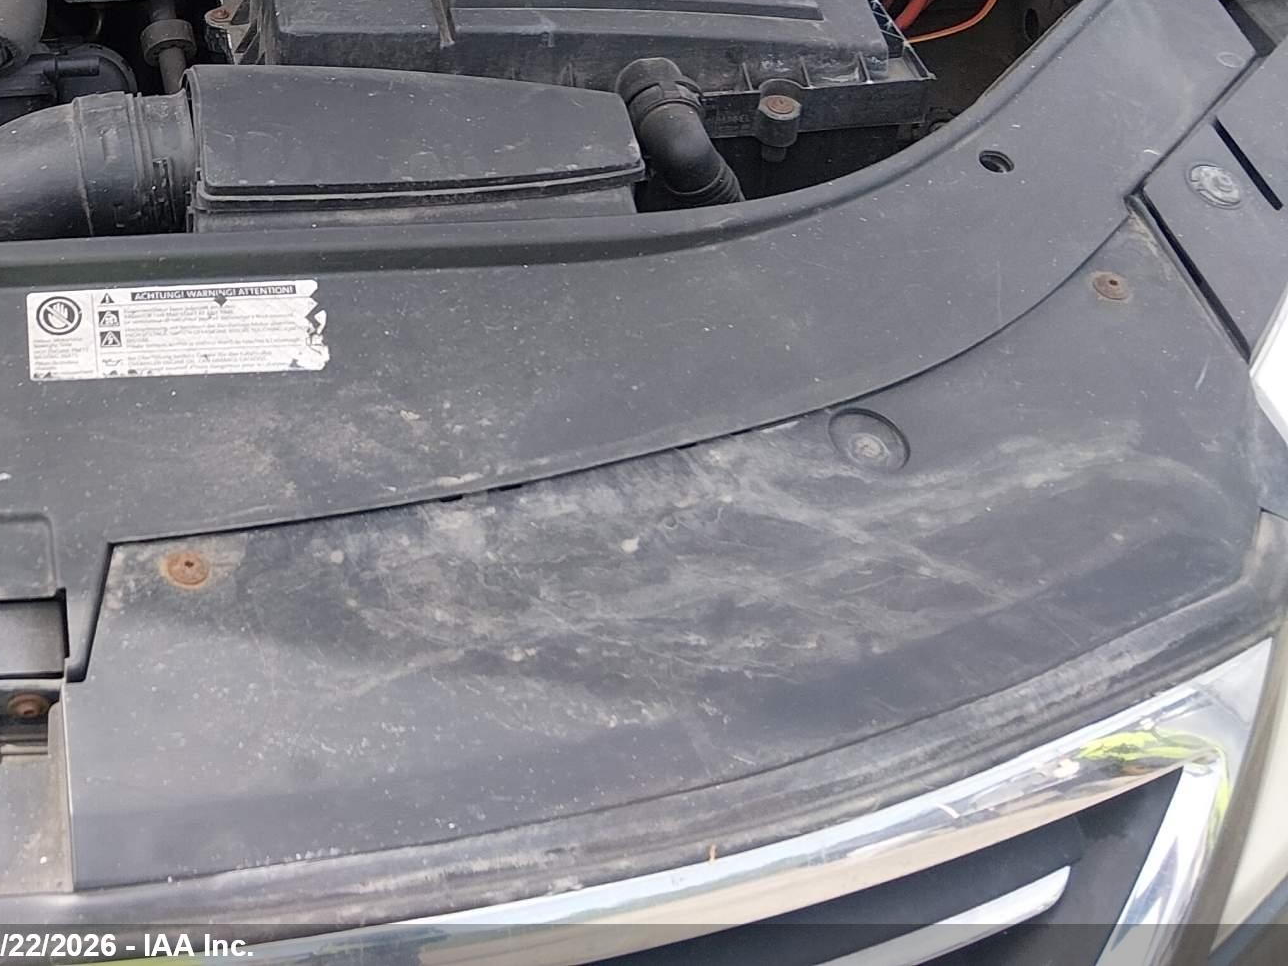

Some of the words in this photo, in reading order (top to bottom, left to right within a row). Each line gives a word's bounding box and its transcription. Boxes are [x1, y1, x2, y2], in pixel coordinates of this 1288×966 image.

[134, 290, 185, 301] ACHTUNG!
[186, 287, 237, 299] WARNING!
[238, 284, 295, 296] ATTENTION!
